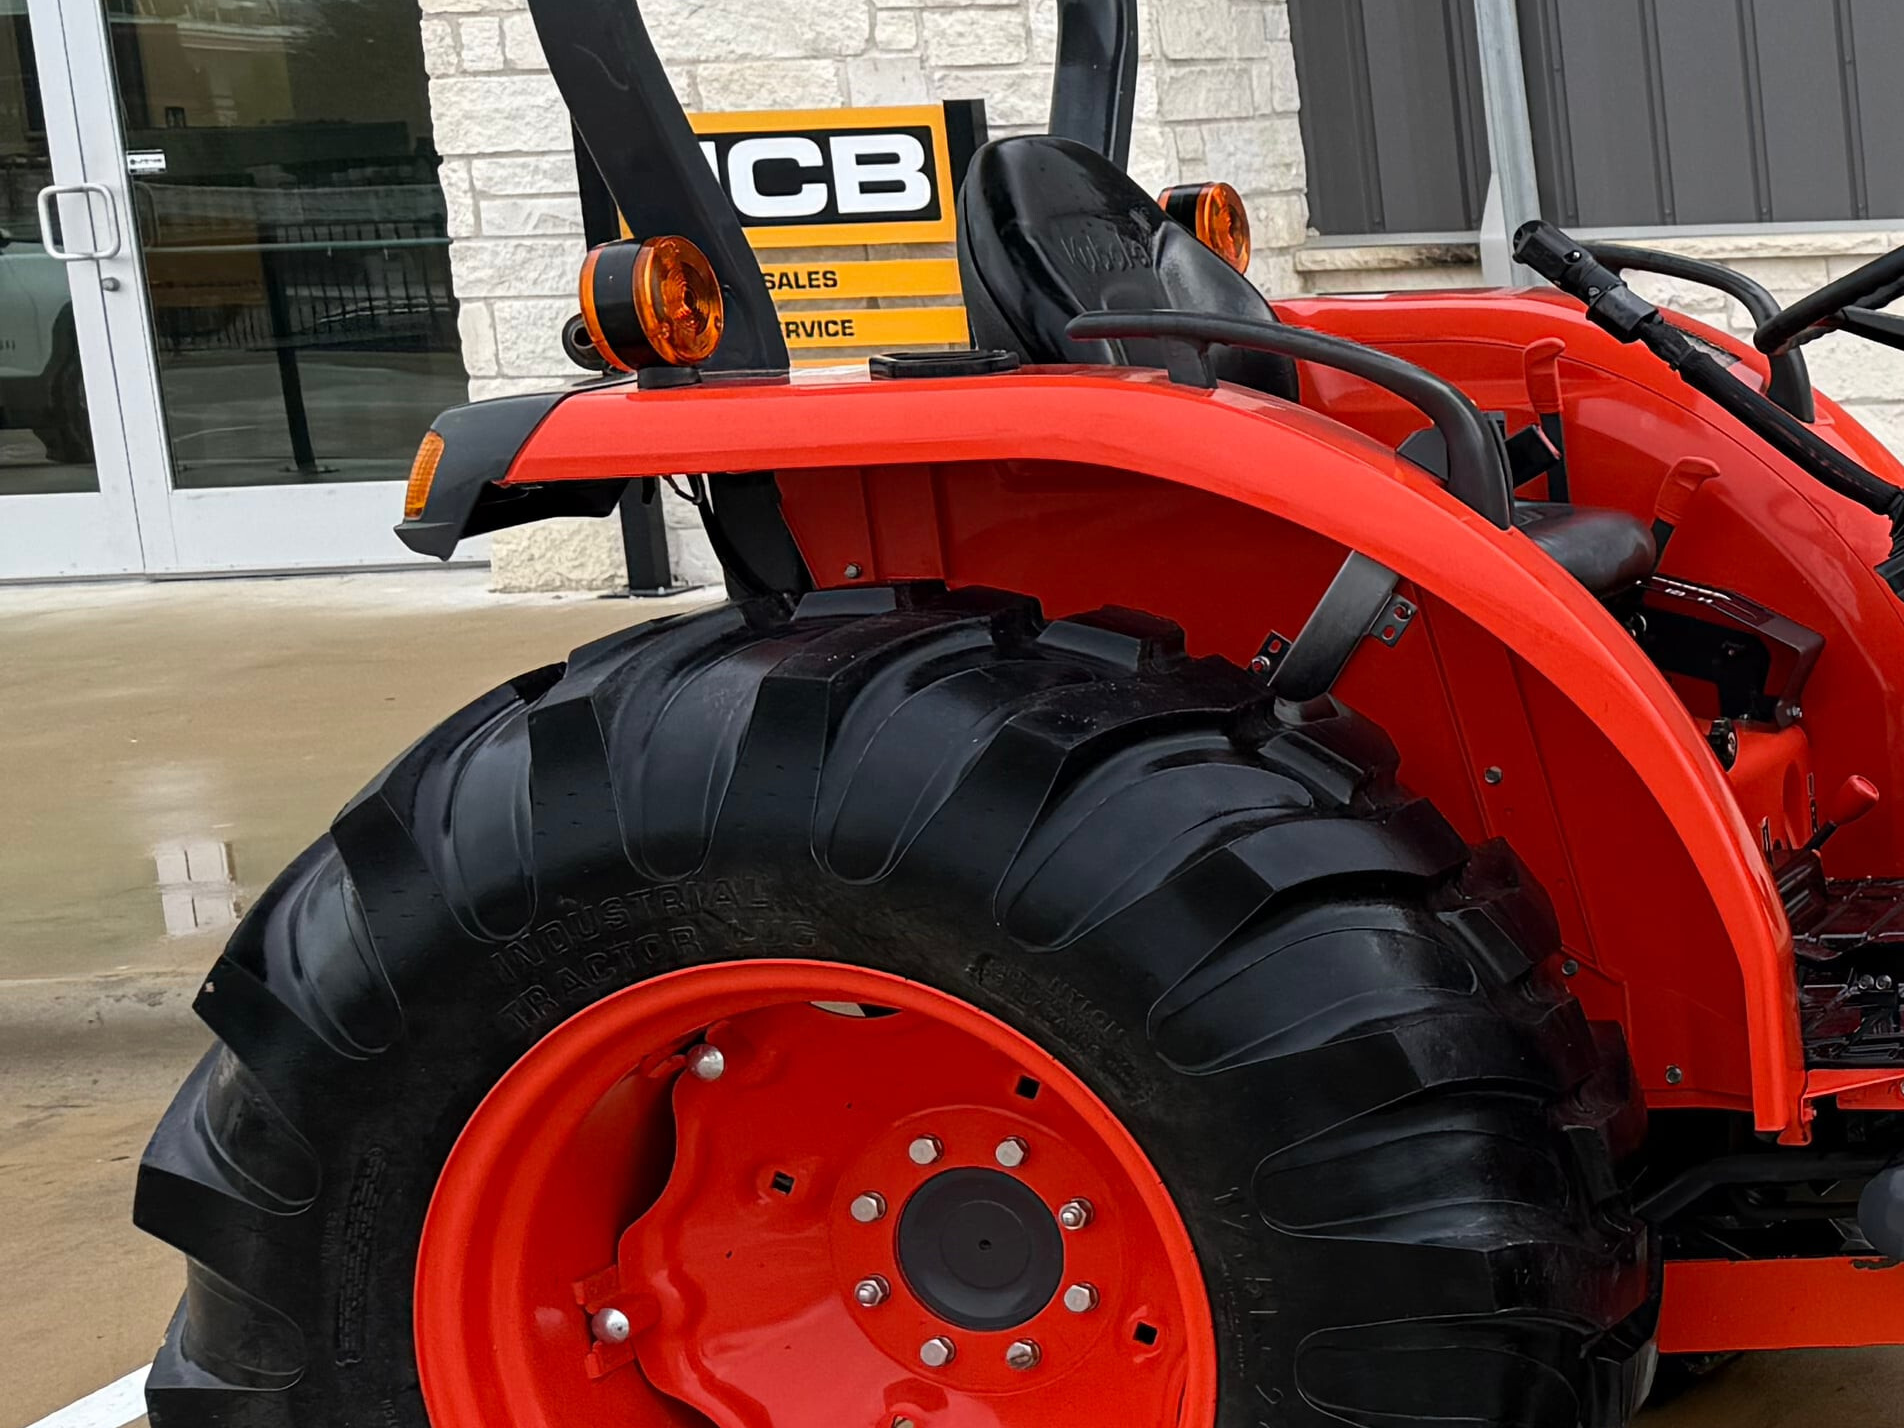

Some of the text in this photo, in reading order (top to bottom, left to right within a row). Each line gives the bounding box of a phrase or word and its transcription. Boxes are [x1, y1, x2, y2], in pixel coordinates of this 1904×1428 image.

[700, 133, 932, 219] CB
[763, 269, 839, 291] SALES
[784, 318, 856, 340] RVICE
[490, 875, 774, 982] INDUSTRIAL
[496, 922, 706, 1033] TRACTOR
